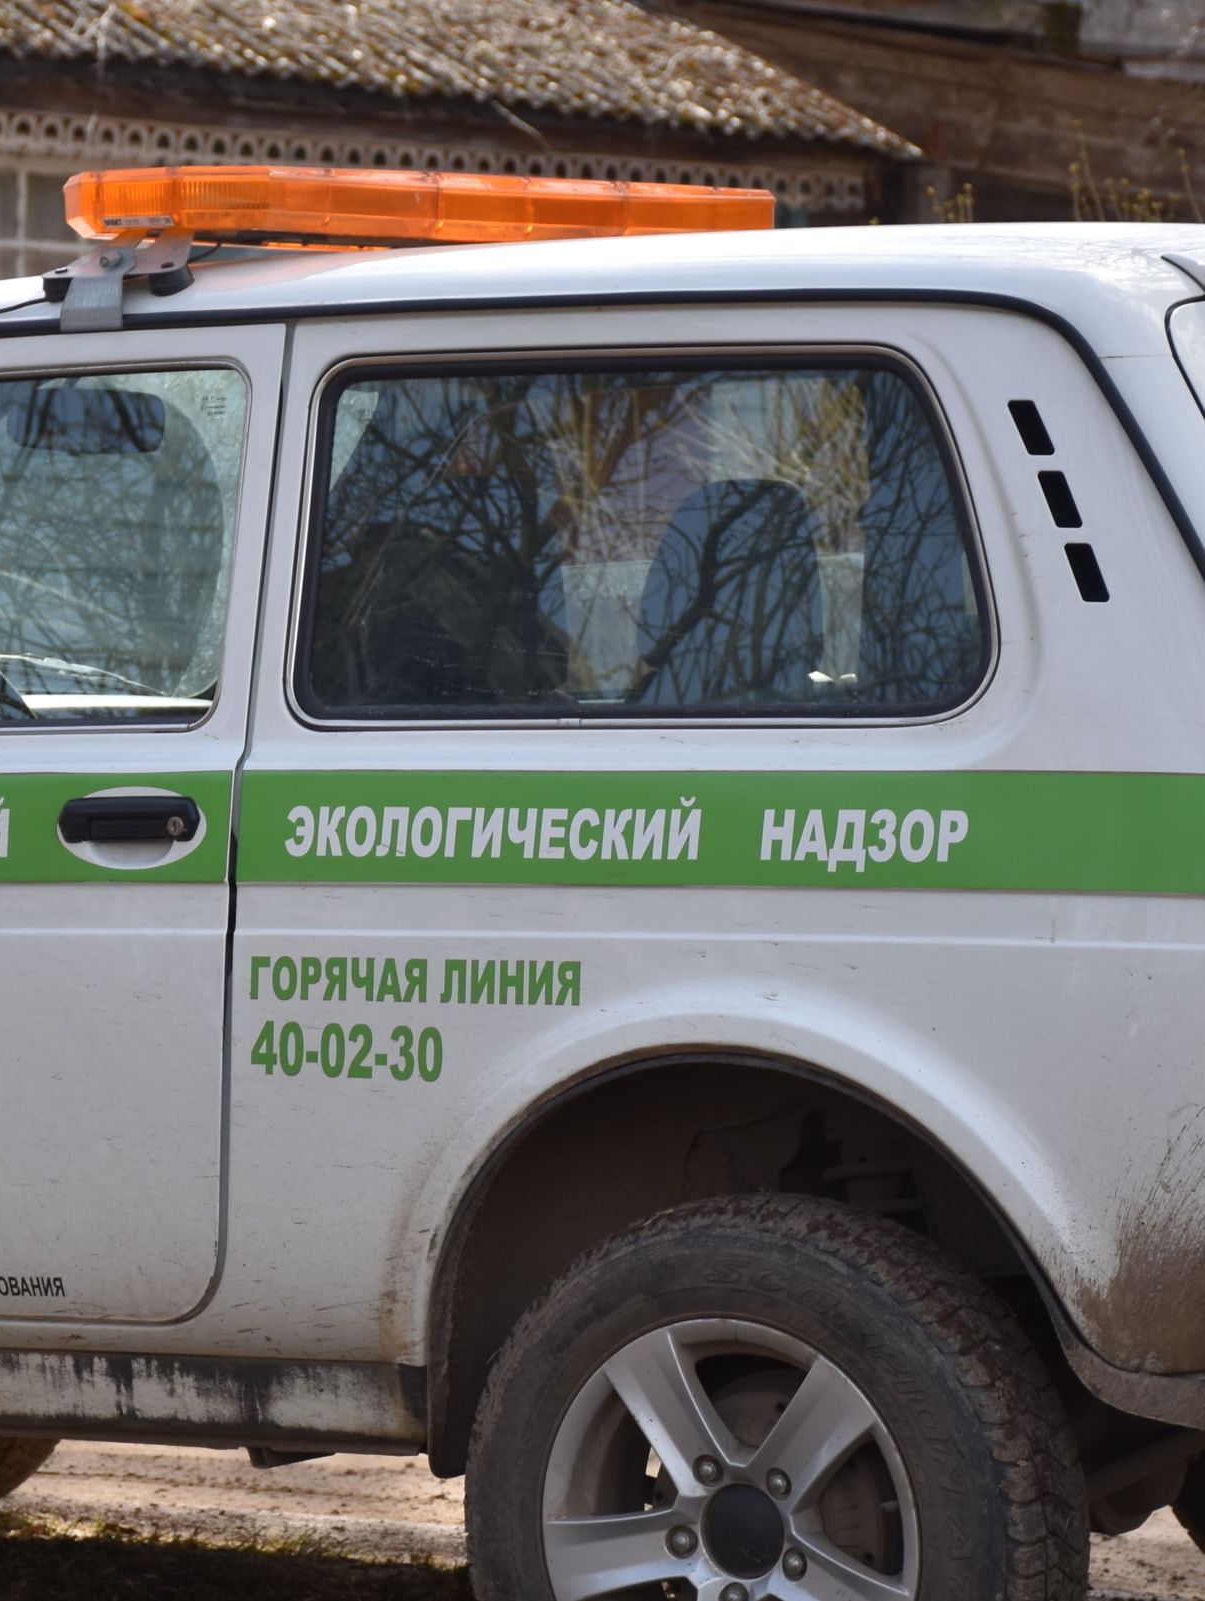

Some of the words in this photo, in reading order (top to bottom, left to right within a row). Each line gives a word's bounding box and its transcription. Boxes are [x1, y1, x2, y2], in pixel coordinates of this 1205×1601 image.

[285, 796, 702, 860] ЭКОЛОГИЧЕСКИЙ
[760, 808, 969, 873] НАДЗОР
[249, 955, 428, 1003] ГОРЯЧАЯ
[440, 958, 582, 1006] ЛИНИЯ
[250, 1020, 444, 1083] 40-02-30
